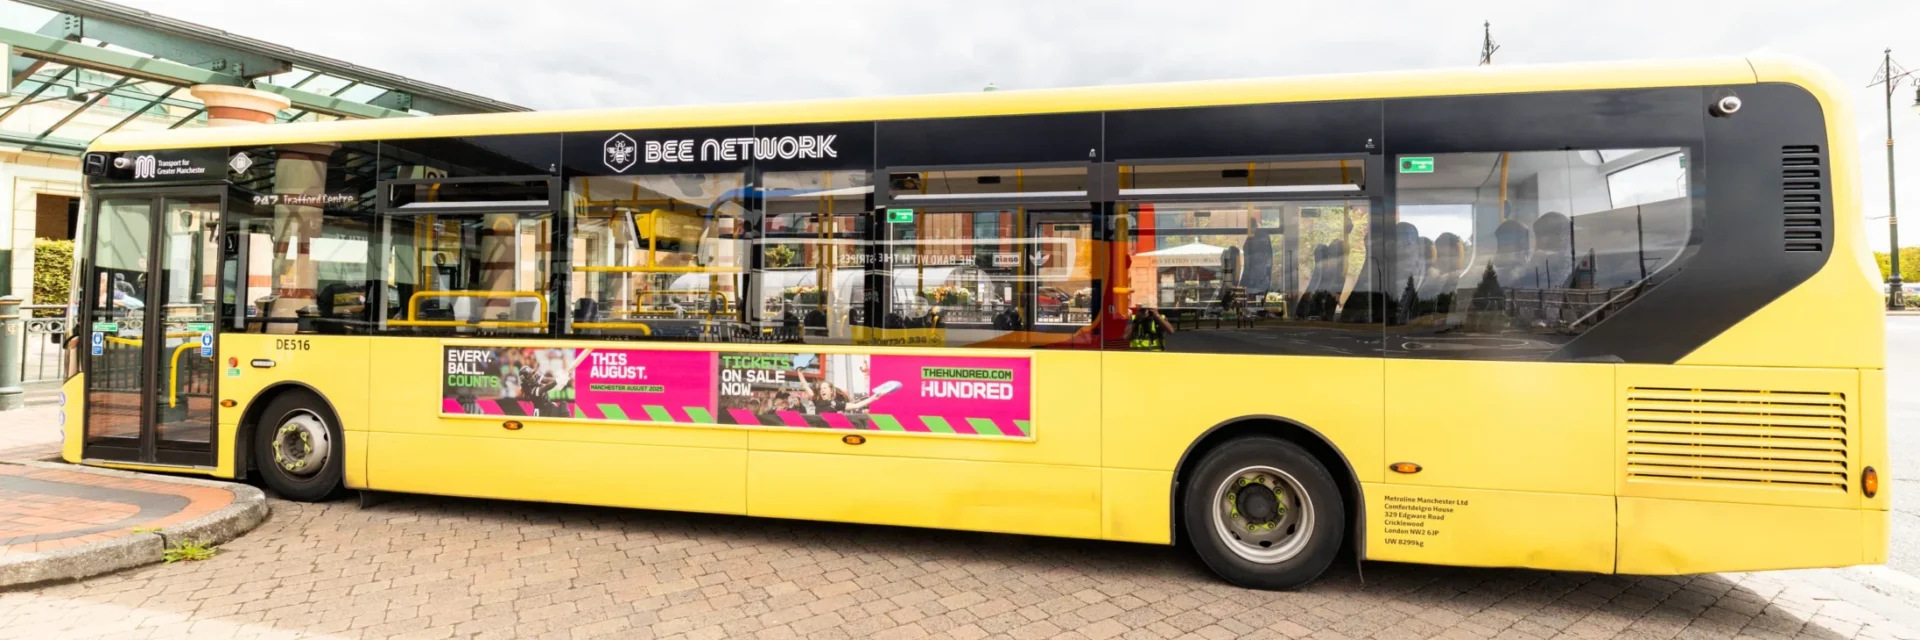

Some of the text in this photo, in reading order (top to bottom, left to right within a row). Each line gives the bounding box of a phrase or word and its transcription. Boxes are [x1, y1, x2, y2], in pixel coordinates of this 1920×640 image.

[645, 134, 837, 163] BEE NETWORK
[158, 160, 181, 168] Transport
[276, 339, 310, 351] DE516
[448, 350, 492, 363] EVERY.
[591, 353, 628, 366] THIS
[722, 355, 791, 369] TICKETS
[448, 362, 485, 375] BALL.
[590, 366, 648, 380] AUGUST.
[922, 368, 1012, 380] THEHUNDRED.COM
[722, 369, 786, 384] ON SALE
[721, 382, 754, 397] NOW.
[921, 381, 1014, 400] HUNDRED
[1384, 495, 1416, 503] Metroline
[1417, 497, 1455, 505] Manchester
[1384, 503, 1432, 512] Comfortdelgro
[1398, 512, 1427, 520] Edgware
[1384, 519, 1424, 527] Cricklewood
[1384, 527, 1409, 535] London
[1398, 539, 1425, 548] 8299kg
